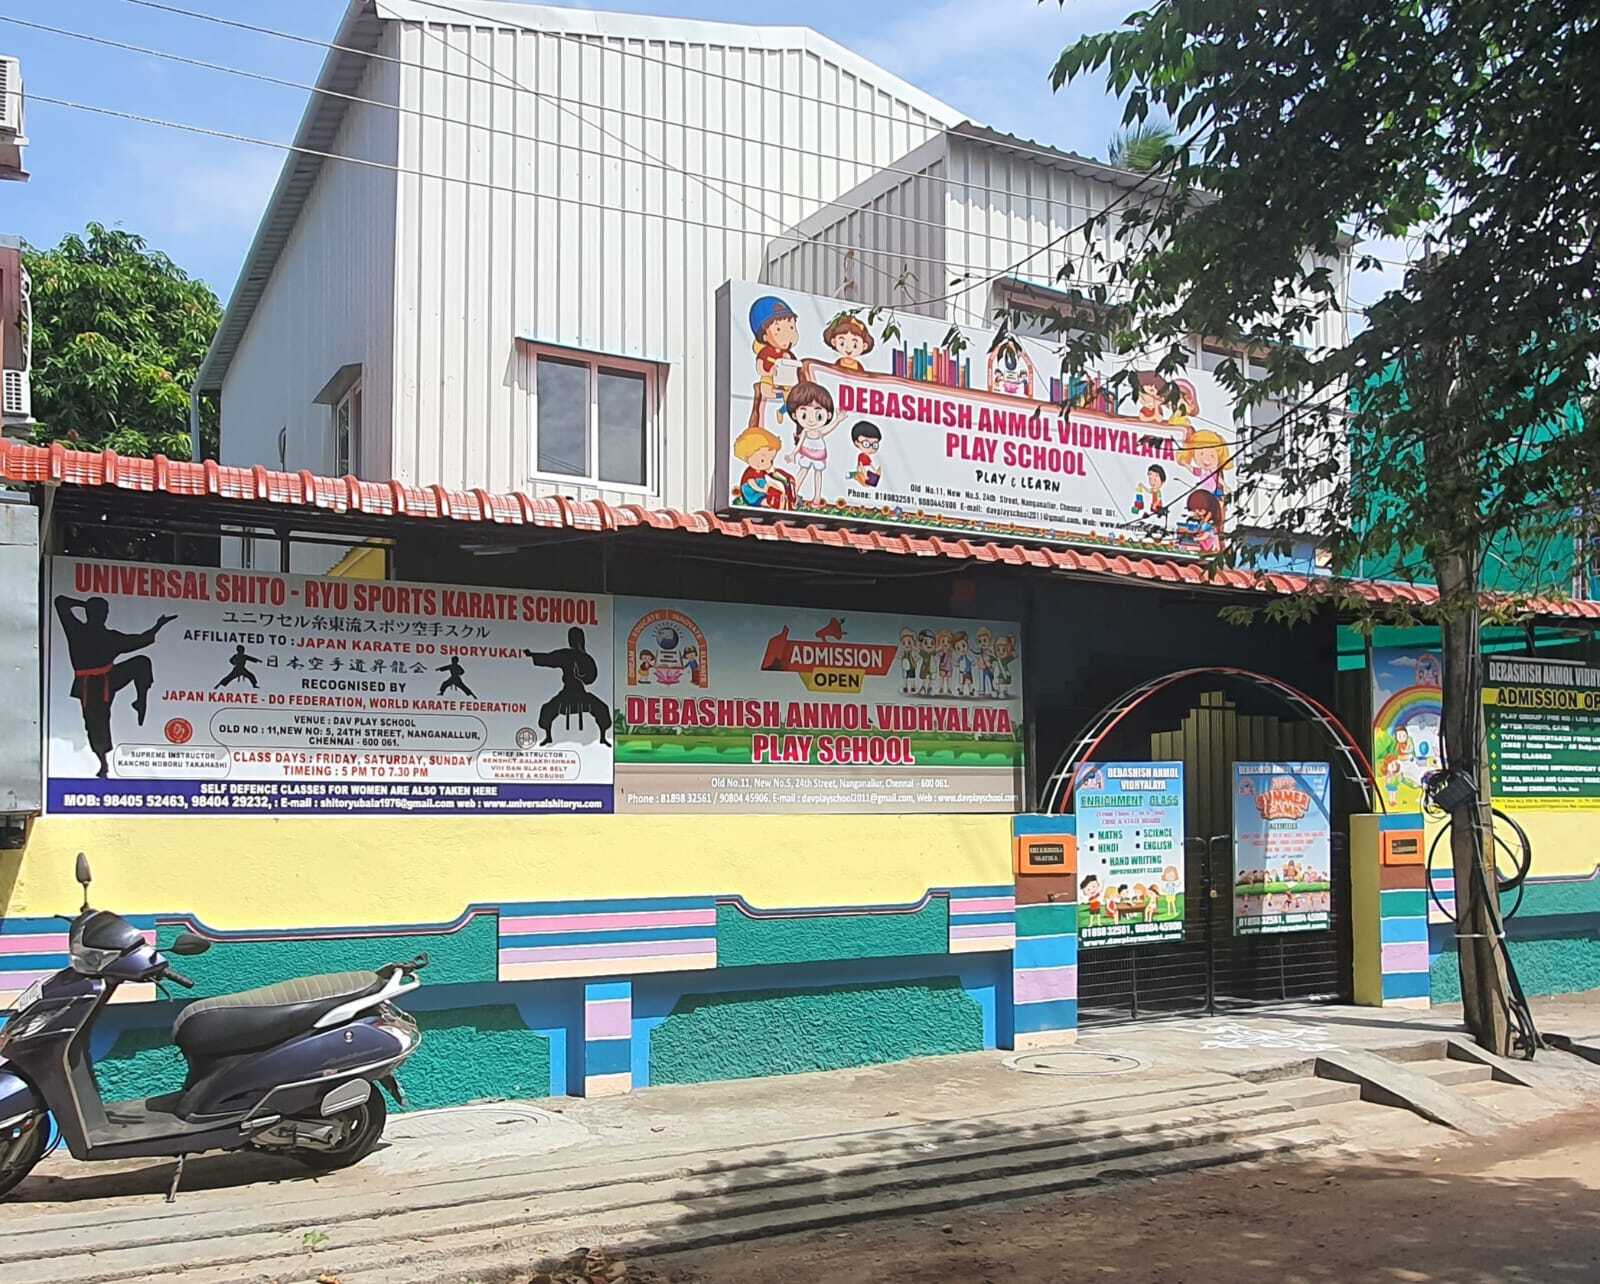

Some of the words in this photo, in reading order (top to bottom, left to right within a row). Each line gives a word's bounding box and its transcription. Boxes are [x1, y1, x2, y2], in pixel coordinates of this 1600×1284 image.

[838, 384, 972, 430] DEBASHISH
[978, 407, 1053, 442] ANMOL
[946, 432, 998, 463] PLAY
[1003, 441, 1087, 477] SCHOOL
[975, 469, 1006, 486] PLAY
[1021, 476, 1061, 492] LEARN
[848, 488, 871, 499] Phone:
[947, 489, 961, 498] New
[75, 562, 210, 602] UNIVERSAL
[215, 573, 285, 606] SHITO
[305, 580, 348, 611] RYU
[353, 583, 437, 616] SPORTS
[442, 590, 518, 621] KARATE
[522, 595, 598, 625] SCHOOL
[184, 629, 264, 644] AFFILIATED
[269, 634, 287, 646] TO
[352, 639, 411, 653] KARATE
[415, 643, 435, 655] DO
[440, 644, 522, 658] SHORYUKAI
[790, 645, 883, 668] ADMISSION
[814, 672, 860, 688] OPEN
[1489, 661, 1542, 684] DEBASHISH
[1543, 664, 1574, 686] ANMOL
[301, 678, 386, 692] RECOGNISED
[390, 682, 407, 693] BY
[162, 690, 204, 702] JAPAN
[208, 692, 258, 704] KARATE
[268, 694, 285, 705] DO
[289, 695, 367, 710] FEDERATION,
[370, 698, 409, 709] WORLD
[412, 699, 456, 711] KARATE
[460, 701, 527, 713] FEDERATION
[1498, 687, 1578, 708] ADMISSION
[294, 715, 325, 725] VENUE
[333, 716, 351, 726] DAV
[354, 717, 378, 727] PLAY
[380, 718, 416, 728] SCHOOL
[626, 696, 780, 728] DEBASHISH
[786, 702, 871, 731] ANMOL
[876, 704, 1012, 733] VIDHYALAYA
[219, 724, 240, 733] OLD
[243, 725, 258, 734] NO
[305, 727, 322, 736] NO:
[326, 728, 334, 738] 5,
[337, 728, 361, 737] 24TH
[364, 729, 405, 739] STREET,
[407, 730, 480, 741] NANGANALLUR,
[308, 737, 354, 746] CHENNAI
[362, 738, 379, 747] 600
[381, 738, 399, 747] 061.
[752, 734, 813, 763] PLAY
[819, 736, 915, 765] SCHOOL
[131, 751, 166, 759] SUPREME
[168, 752, 216, 760] INSTRUCTOR
[233, 751, 271, 763] CLASS
[275, 752, 306, 763] DAYS
[316, 753, 361, 765] FRIDAY,
[364, 754, 426, 766] SATURDAY,
[429, 755, 473, 766] SUNDAY
[516, 751, 564, 759] INSTRUCTOR
[117, 759, 150, 767] KANCHO
[185, 761, 228, 769] TAKAHASHI
[283, 765, 332, 776] TIMEING
[341, 766, 348, 776] 5
[351, 766, 367, 777] PM
[371, 766, 385, 777] TO
[388, 767, 410, 777] 7.30
[413, 767, 428, 777] PM
[200, 783, 228, 794] SELF
[230, 783, 278, 795] DEFENCE
[280, 784, 326, 795] CLASSES
[328, 785, 348, 795] FOR
[350, 785, 388, 796] WOMEN
[390, 785, 410, 796] ARE
[411, 785, 437, 796] ALSO
[439, 786, 471, 796] TAKEN
[473, 786, 498, 796] HERE
[711, 777, 725, 788] Old
[754, 778, 771, 788] New
[795, 778, 812, 788] 24th
[63, 794, 100, 807] MOB:
[103, 794, 143, 808] 98405
[145, 795, 188, 809] 52463,
[191, 795, 229, 808] 98404
[231, 795, 272, 810] 29232,
[280, 797, 312, 808] E-mail
[456, 798, 476, 808] web
[627, 793, 654, 803] Phone
[1080, 794, 1143, 808] ENRICHMENT
[1149, 794, 1179, 807] CLASS
[1098, 830, 1123, 840] MATHS
[1143, 828, 1172, 838] SCIENCE
[1098, 843, 1119, 853] HINDI
[1143, 840, 1172, 850] ENGLISH
[1109, 856, 1130, 866] HAND
[1130, 855, 1162, 865] WRITING
